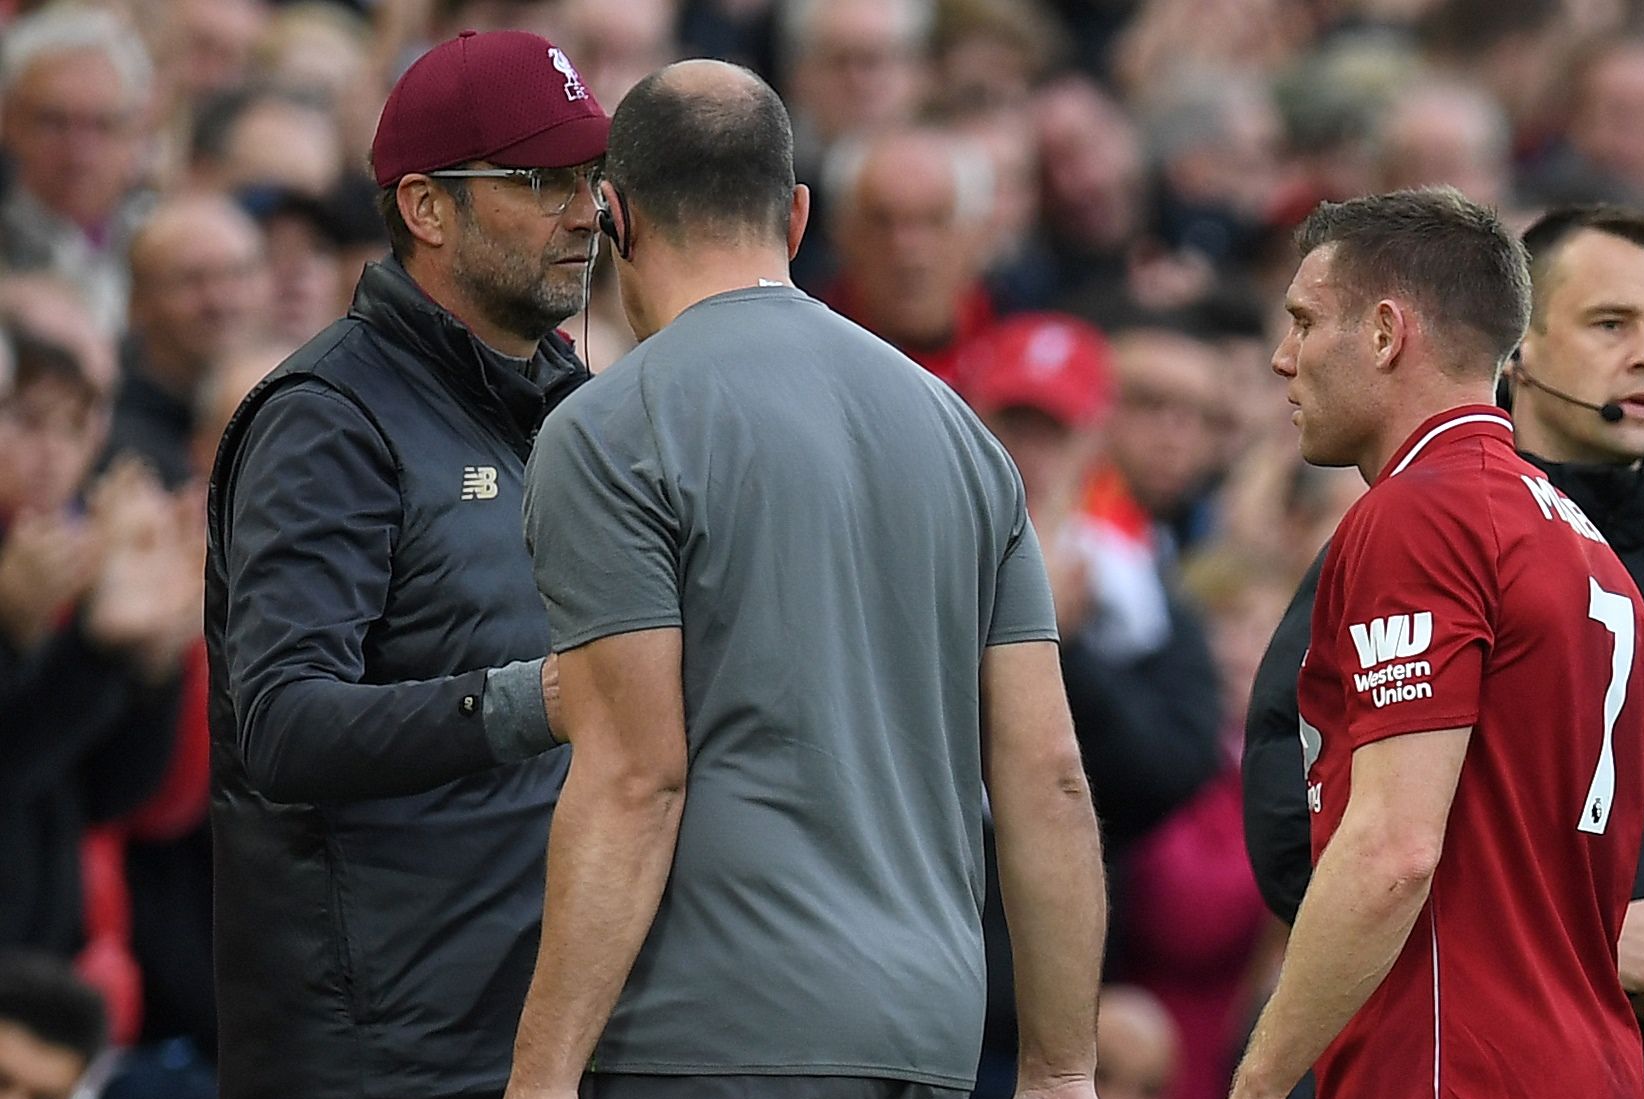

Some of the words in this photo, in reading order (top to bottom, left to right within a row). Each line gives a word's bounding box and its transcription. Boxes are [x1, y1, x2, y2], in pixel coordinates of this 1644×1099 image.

[1349, 611, 1433, 669] WU
[1354, 660, 1431, 692] Western
[1372, 681, 1432, 708] Union
[1577, 575, 1636, 835] 7
